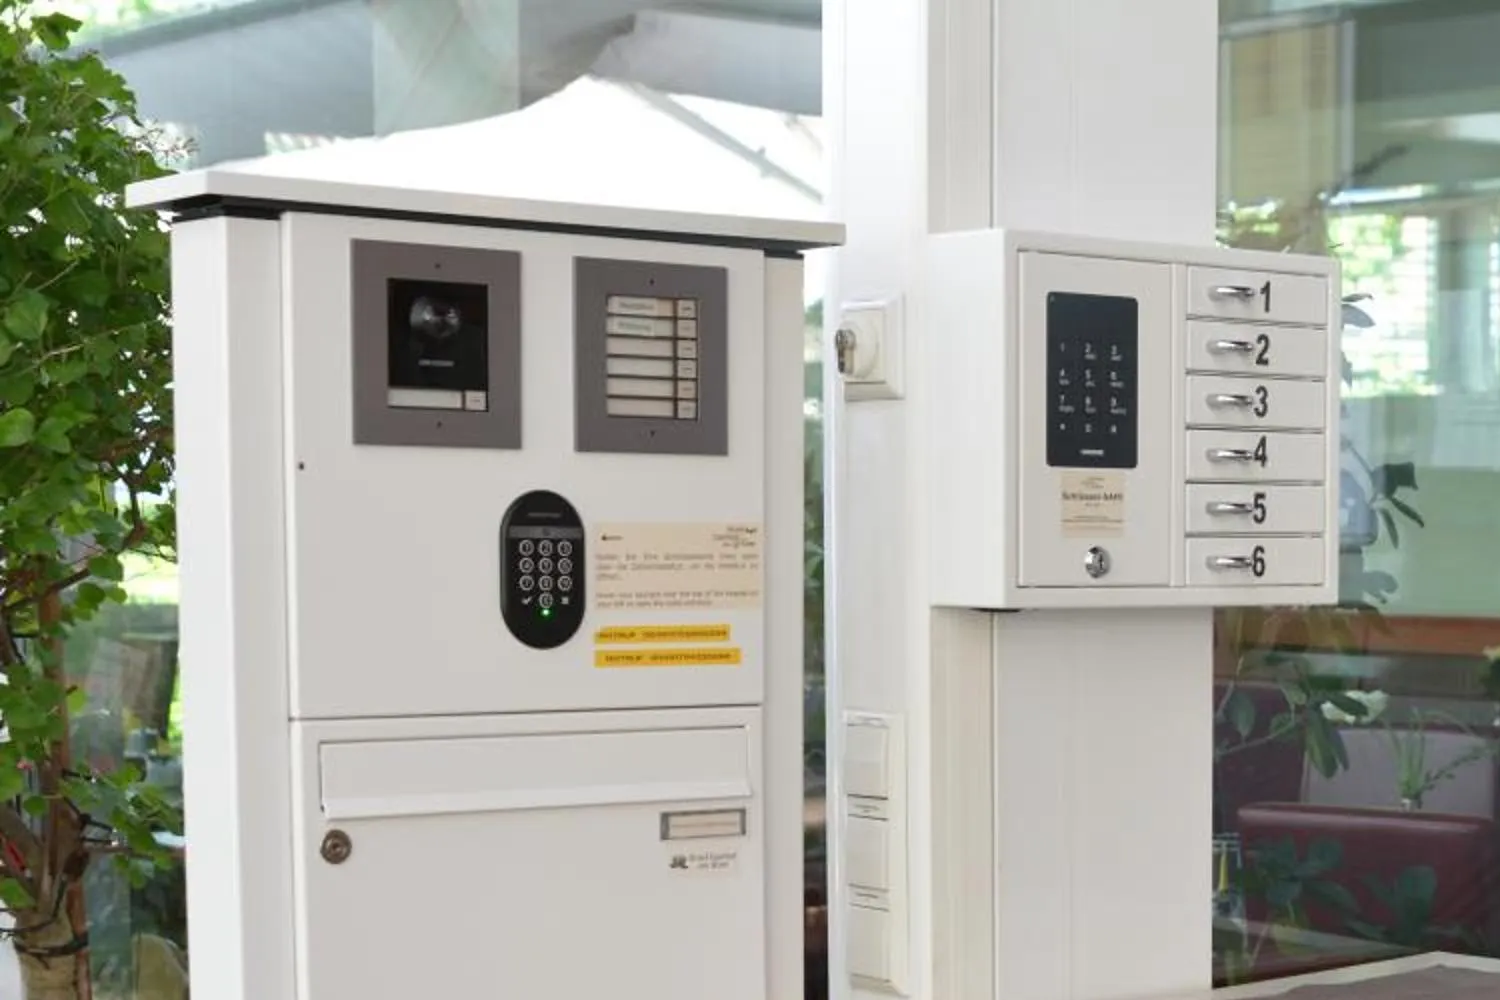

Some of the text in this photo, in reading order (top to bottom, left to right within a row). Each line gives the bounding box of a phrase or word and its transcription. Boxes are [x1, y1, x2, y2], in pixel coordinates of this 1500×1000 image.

[1260, 280, 1270, 313] 1
[1256, 333, 1270, 366] 2
[1253, 385, 1268, 418] 3
[1253, 434, 1267, 468] 4
[1253, 491, 1267, 524] 5
[1252, 545, 1266, 577] 6
